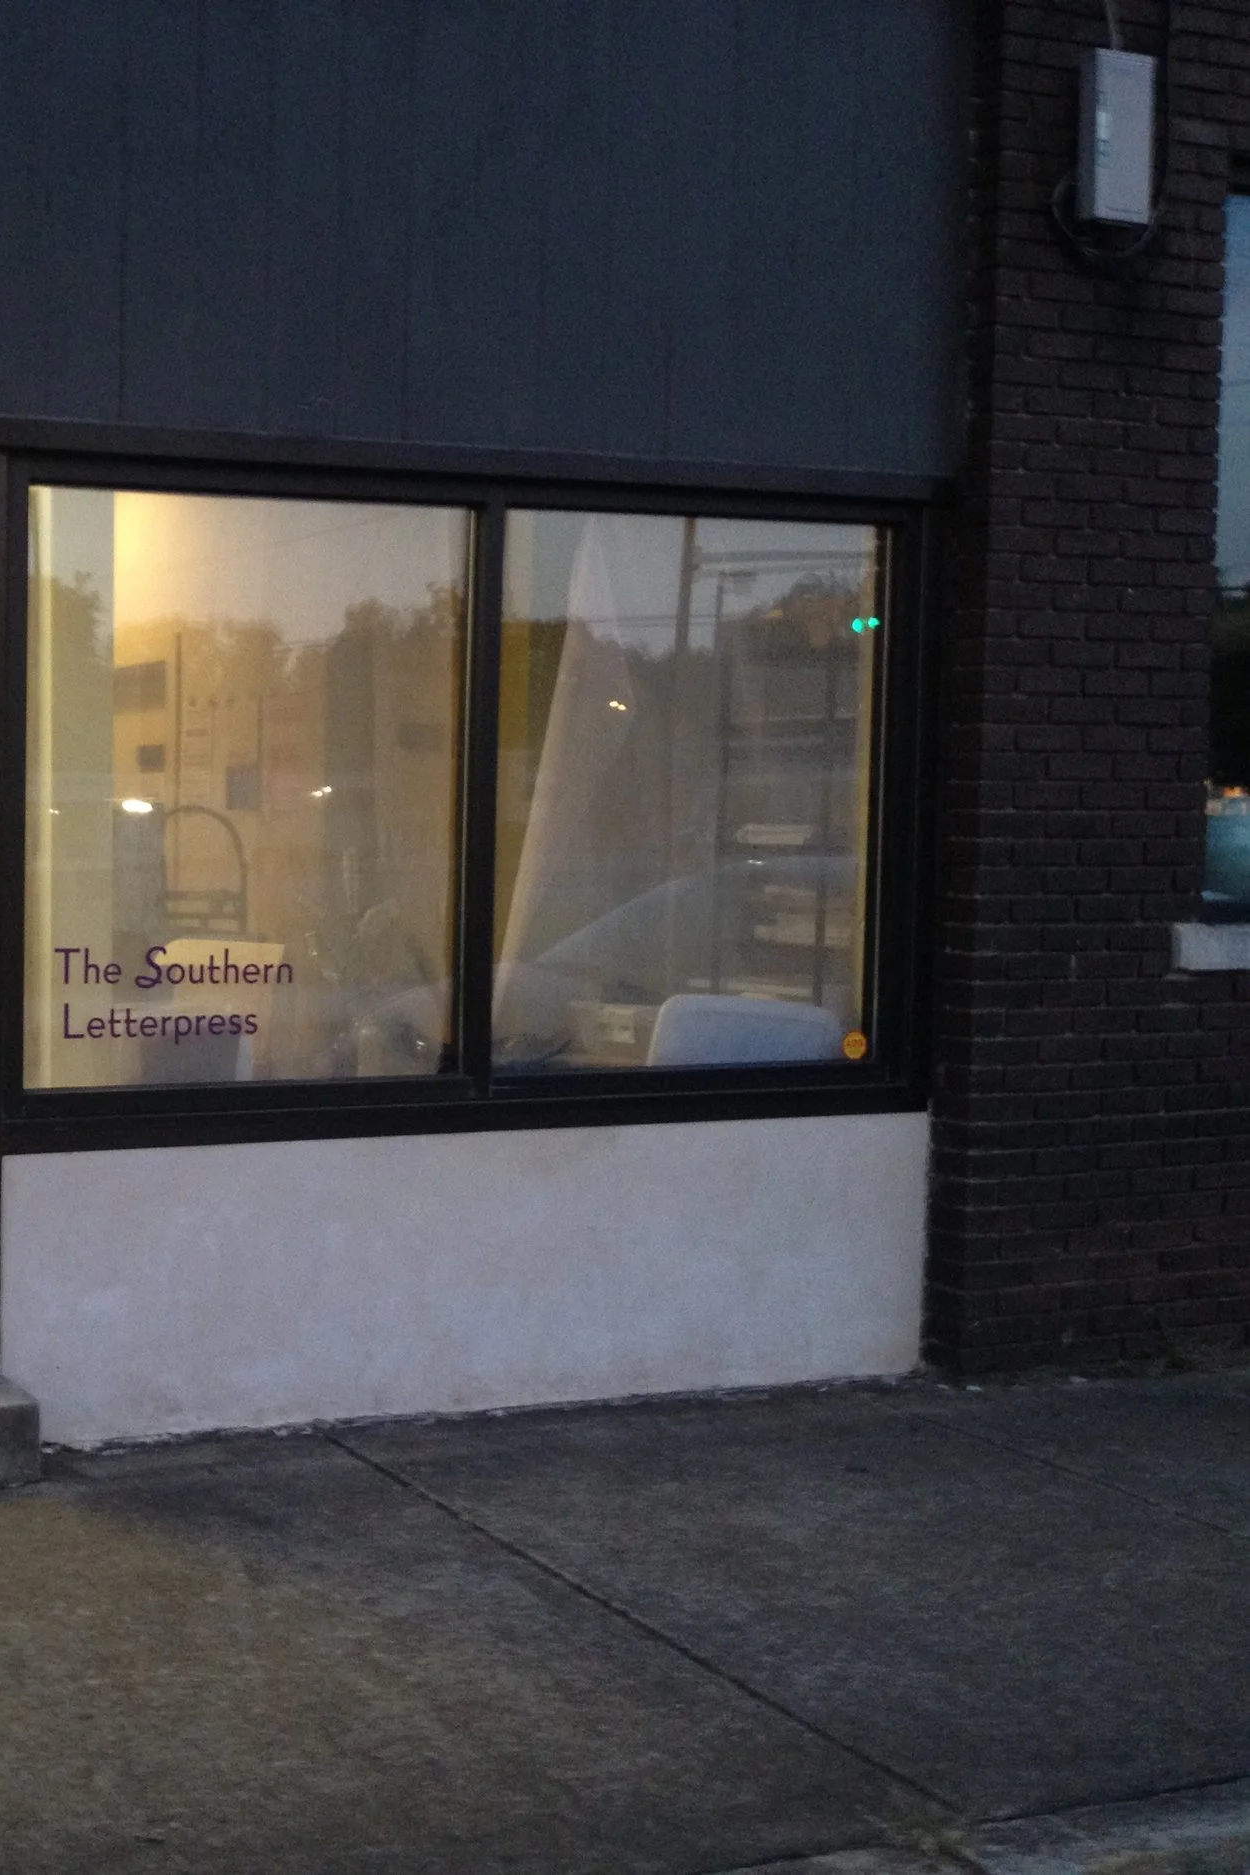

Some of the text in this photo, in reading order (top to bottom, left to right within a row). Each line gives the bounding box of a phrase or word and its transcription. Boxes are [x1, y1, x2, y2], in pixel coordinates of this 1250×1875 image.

[54, 946, 294, 989] The Southern
[63, 1002, 259, 1045] Letterpress
